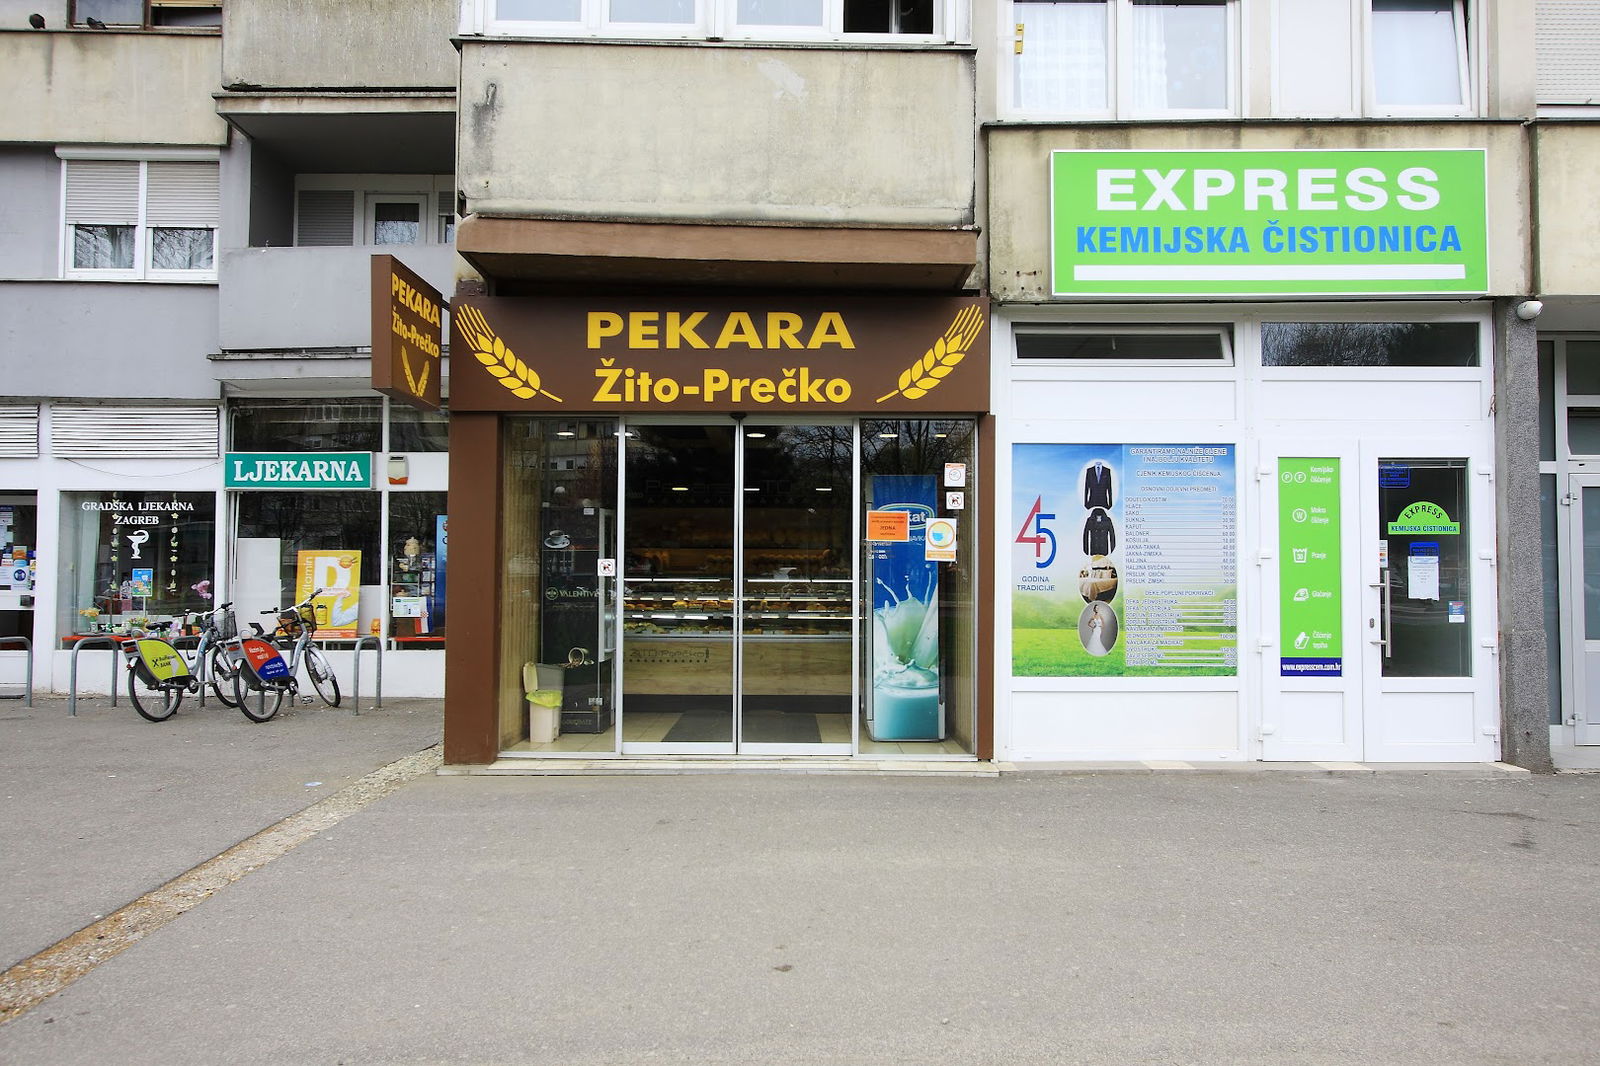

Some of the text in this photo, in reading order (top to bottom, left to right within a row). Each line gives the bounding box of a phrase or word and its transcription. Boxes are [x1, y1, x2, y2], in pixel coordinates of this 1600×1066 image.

[1095, 167, 1441, 212] EXPRESS
[1077, 219, 1462, 254] KEMIJSKA ČISTIONICA
[391, 272, 441, 328] PEKARA
[392, 305, 440, 358] Žito-Prečko
[587, 311, 856, 350] PEKARA
[593, 358, 853, 405] Žito-Prečko
[233, 460, 364, 482] LJEKARNA
[81, 501, 194, 511] GRADSKA LJEKARNA
[115, 515, 159, 525] ZAGREB
[1404, 505, 1443, 519] EXPRESS
[1015, 495, 1057, 569] 45
[1021, 575, 1050, 583] GODINA
